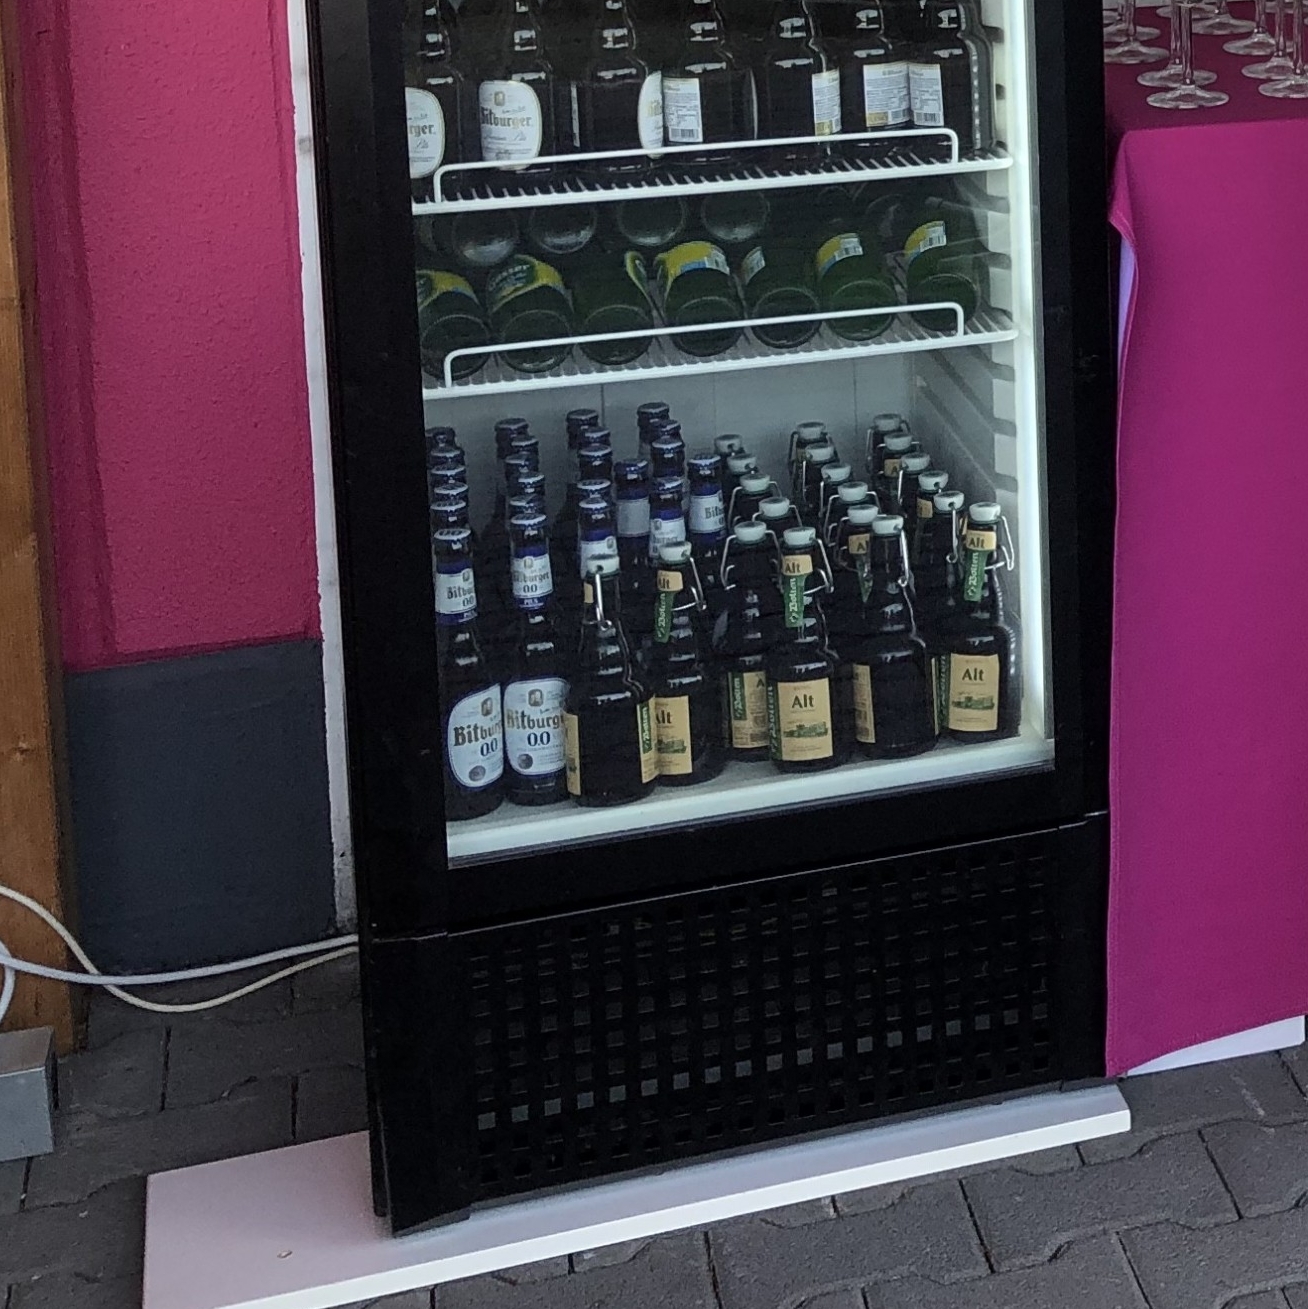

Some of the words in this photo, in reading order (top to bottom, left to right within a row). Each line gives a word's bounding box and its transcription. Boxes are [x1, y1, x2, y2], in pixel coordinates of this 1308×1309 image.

[969, 538, 986, 549] Alt
[785, 561, 801, 574] Alt
[962, 668, 984, 681] Alt
[792, 695, 814, 709] Alt
[506, 709, 562, 730] Bitburg
